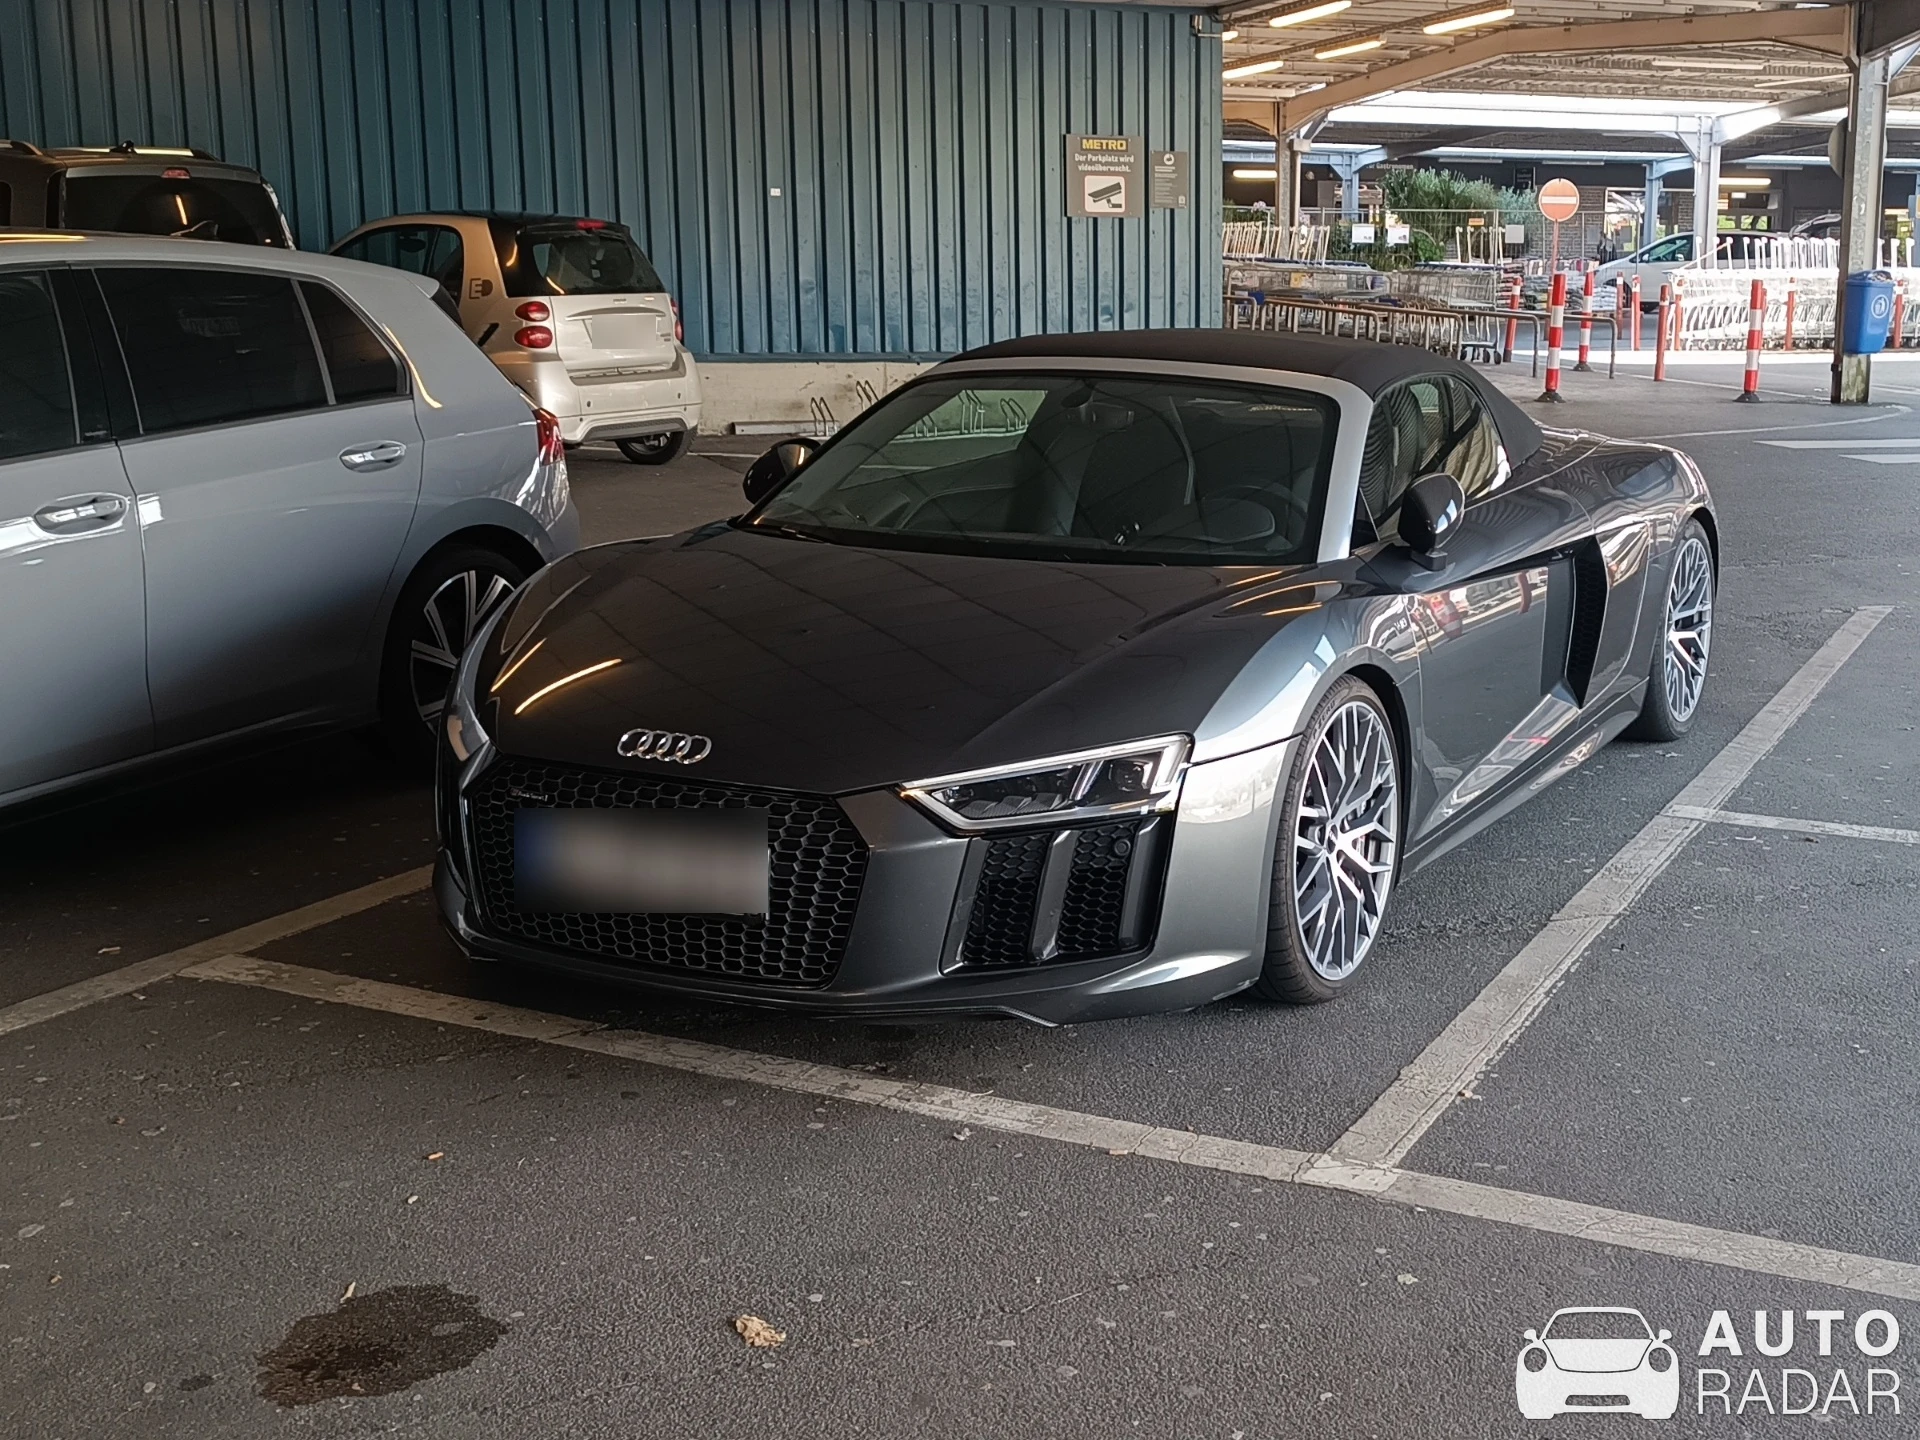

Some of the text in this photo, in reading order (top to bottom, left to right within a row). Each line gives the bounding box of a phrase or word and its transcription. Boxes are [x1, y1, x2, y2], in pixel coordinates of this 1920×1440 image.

[1082, 139, 1127, 150] METRO
[1074, 153, 1134, 163] Der Parkplatz wird
[1078, 163, 1131, 172] videoüberwacht.
